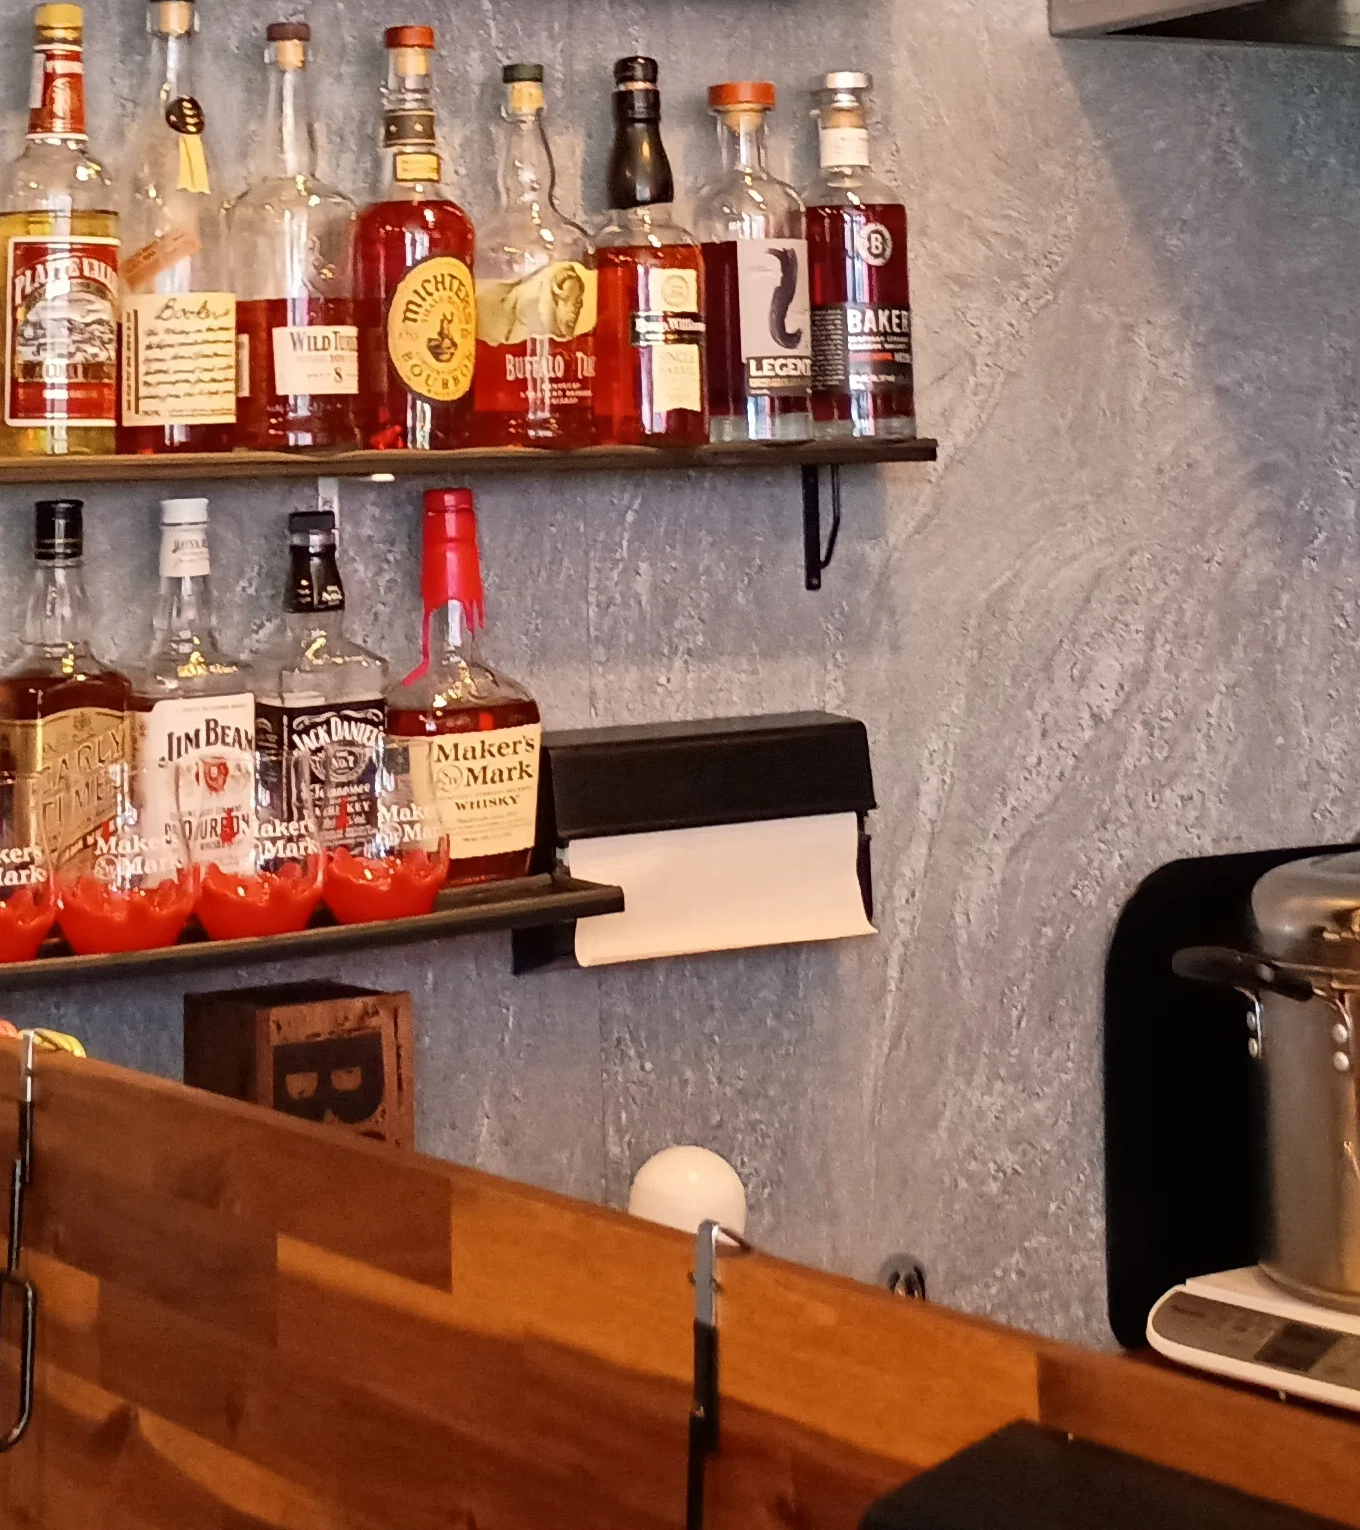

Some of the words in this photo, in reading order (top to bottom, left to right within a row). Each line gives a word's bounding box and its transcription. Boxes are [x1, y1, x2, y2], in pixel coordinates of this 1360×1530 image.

[289, 331, 332, 352] WILD
[157, 728, 201, 769] JIM
[433, 735, 536, 763] Maker's
[466, 760, 534, 787] Mark
[454, 794, 520, 812] WHISKY
